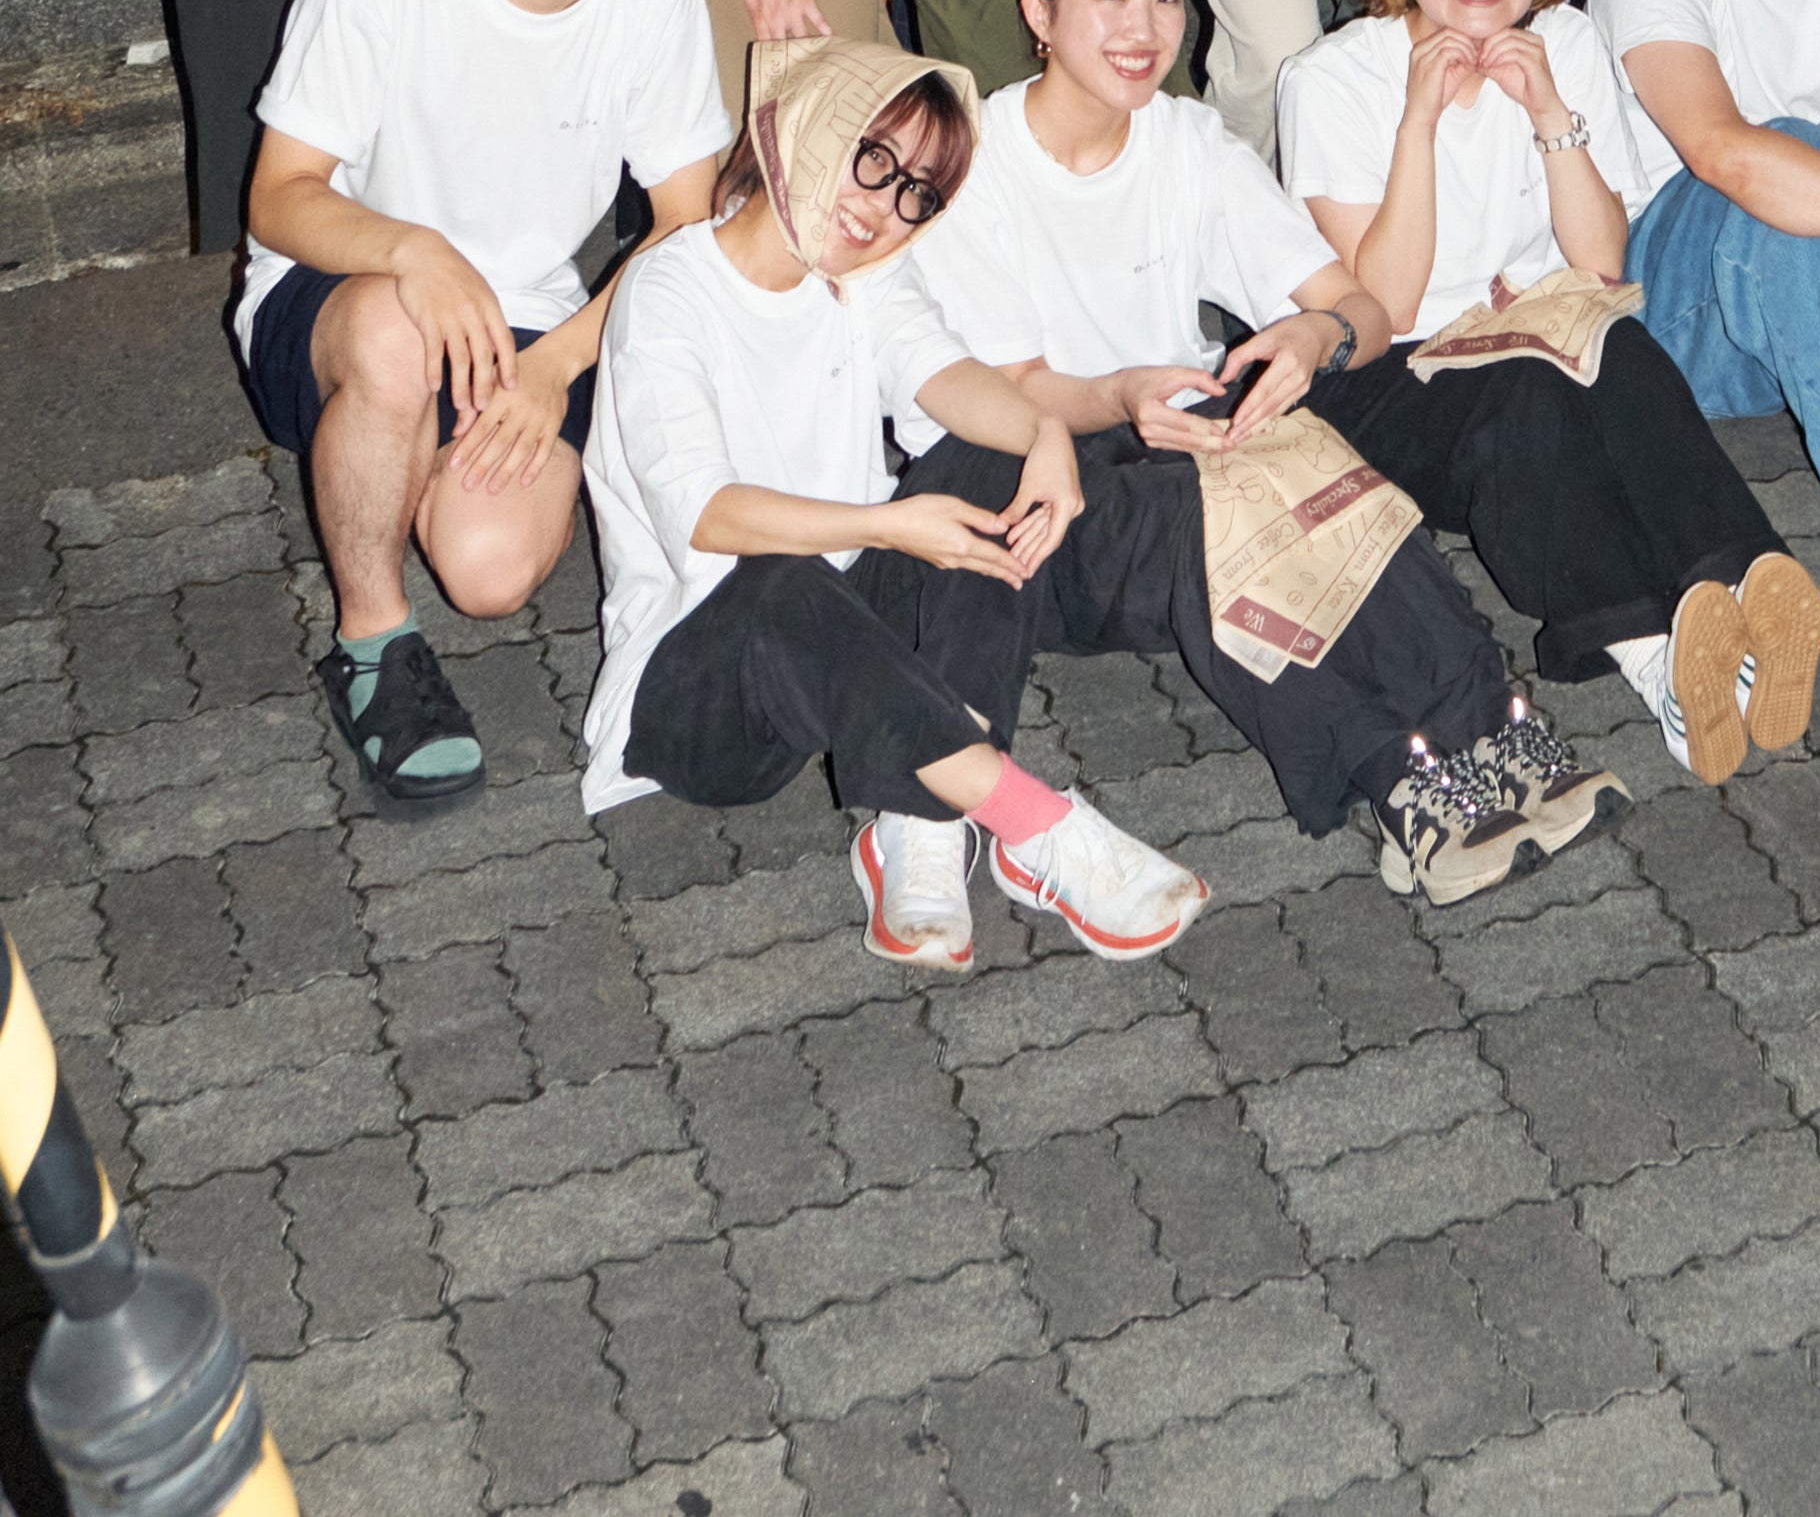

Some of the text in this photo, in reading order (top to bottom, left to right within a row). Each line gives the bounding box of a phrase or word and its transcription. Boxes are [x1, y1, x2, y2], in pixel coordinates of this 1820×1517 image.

[1305, 476, 1361, 518] Specialty
[1257, 522, 1295, 550] Coffee
[1222, 548, 1255, 581] from
[1355, 535, 1383, 571] from
[1243, 608, 1266, 633] We
